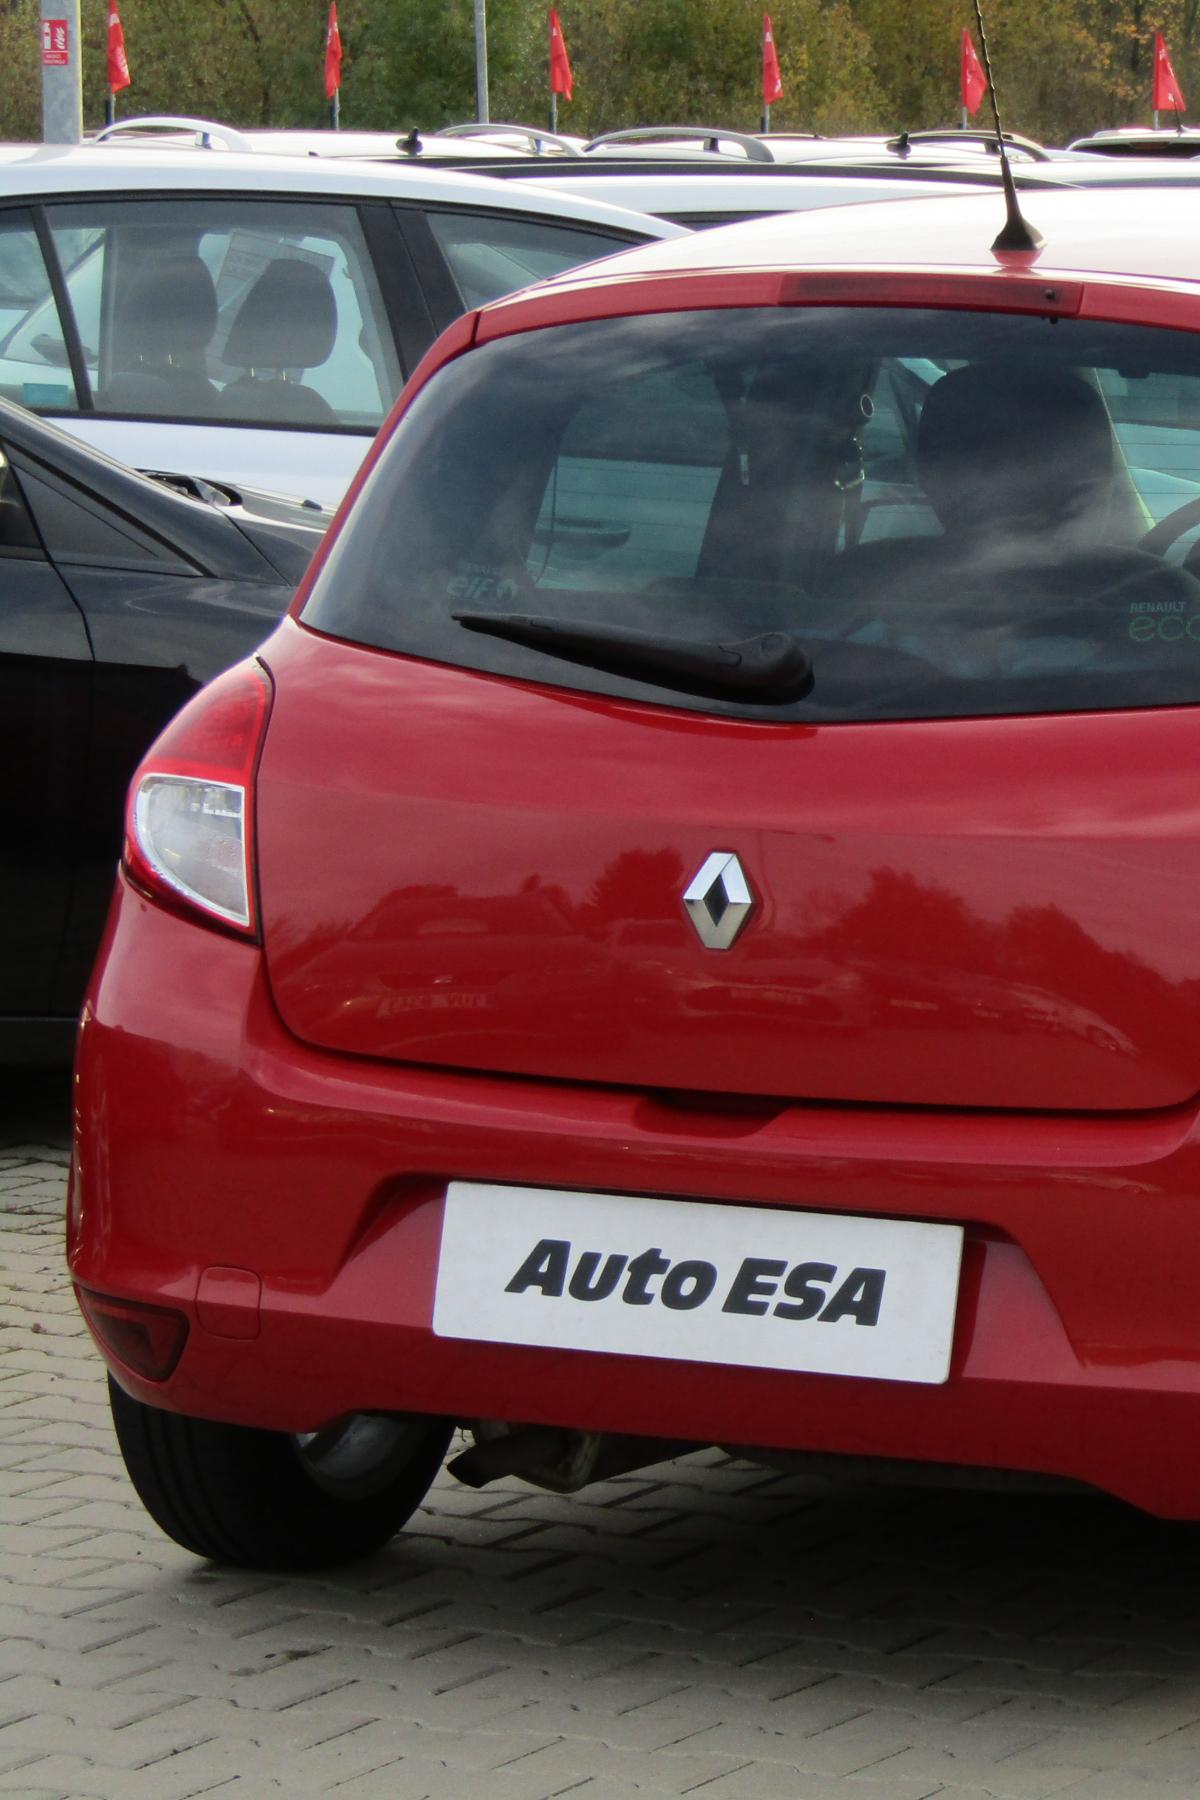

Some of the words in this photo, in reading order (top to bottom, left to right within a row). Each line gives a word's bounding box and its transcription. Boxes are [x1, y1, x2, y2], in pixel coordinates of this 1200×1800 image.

[1129, 601, 1187, 613] RENAULT
[503, 1237, 719, 1311] Auto
[720, 1256, 888, 1328] ESA
